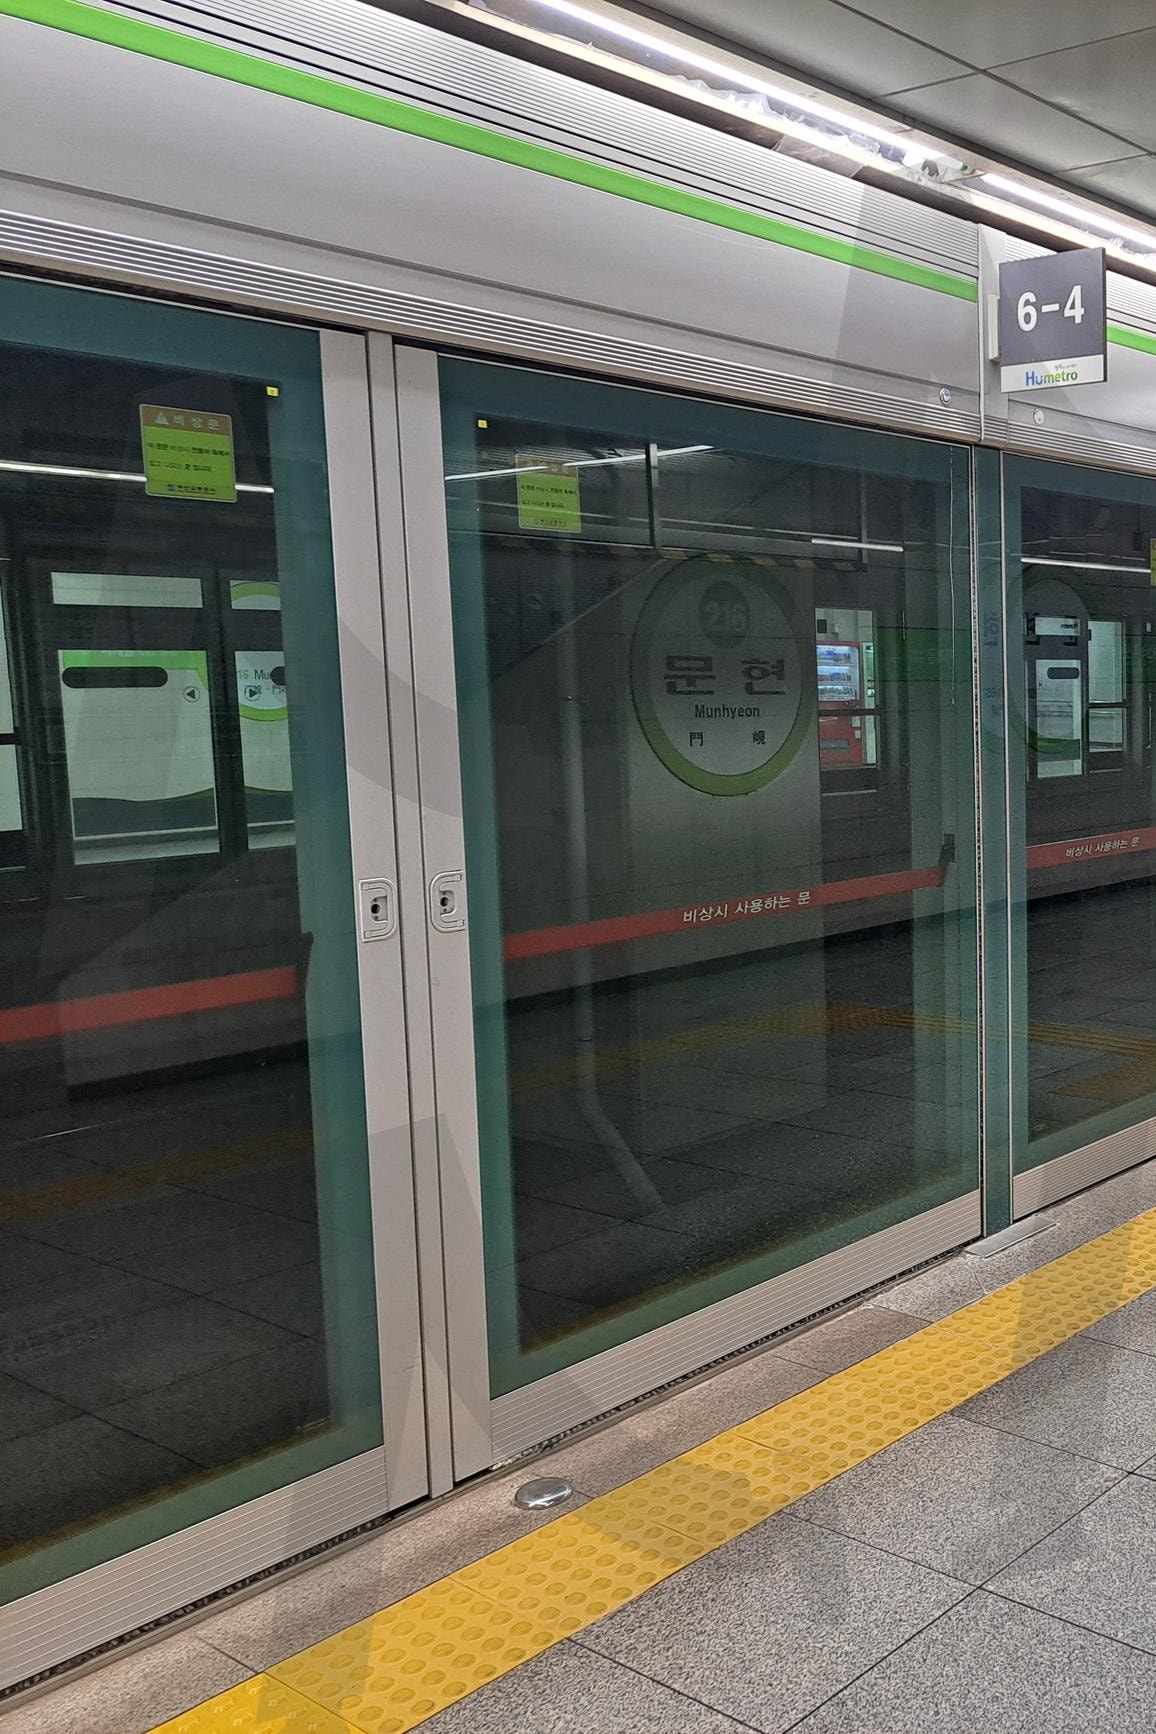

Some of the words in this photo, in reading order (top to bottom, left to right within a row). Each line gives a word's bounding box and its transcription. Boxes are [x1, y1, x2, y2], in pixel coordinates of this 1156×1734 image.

[1017, 284, 1085, 332] 6-4
[1025, 370, 1078, 386] Humetro
[694, 704, 760, 720] Munhyeon
[1066, 845, 1092, 858] 비상시
[1095, 838, 1128, 853] 사용하는
[1131, 836, 1140, 847] 문
[683, 903, 728, 923] 비상시
[734, 895, 791, 915] 사용하는
[797, 891, 811, 905] 문
